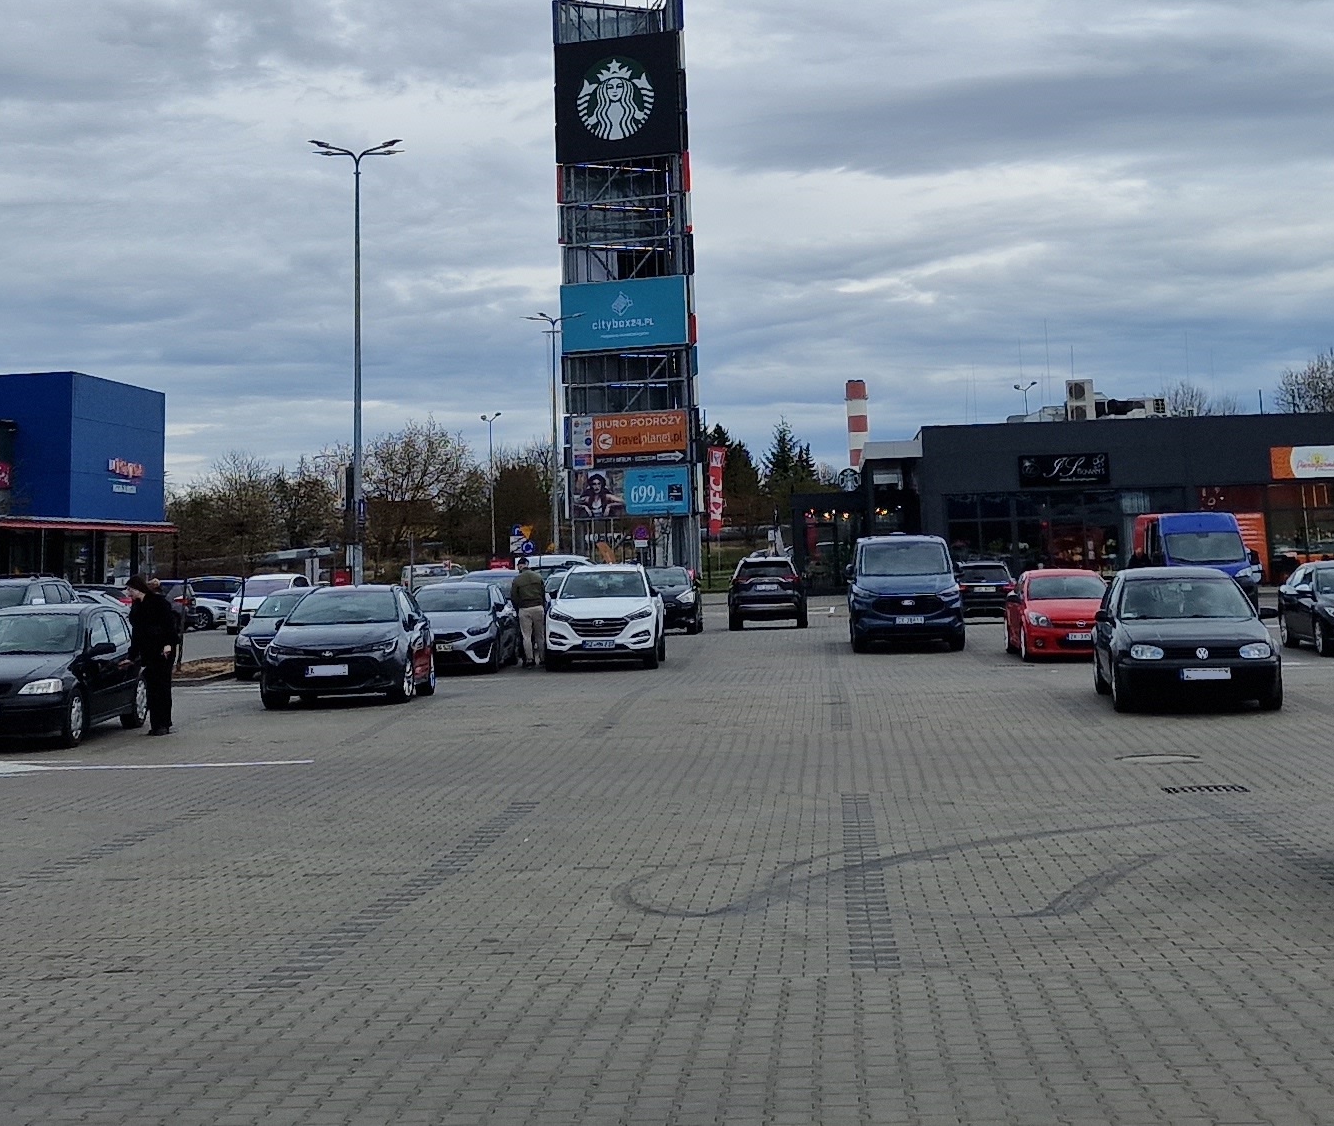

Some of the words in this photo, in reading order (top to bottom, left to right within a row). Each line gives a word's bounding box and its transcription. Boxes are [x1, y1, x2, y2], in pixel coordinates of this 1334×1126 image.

[594, 419, 627, 430] BIURO
[630, 415, 682, 428] PODRÓŻY
[615, 431, 683, 447] travelplanet.pl
[709, 476, 723, 521] KFC
